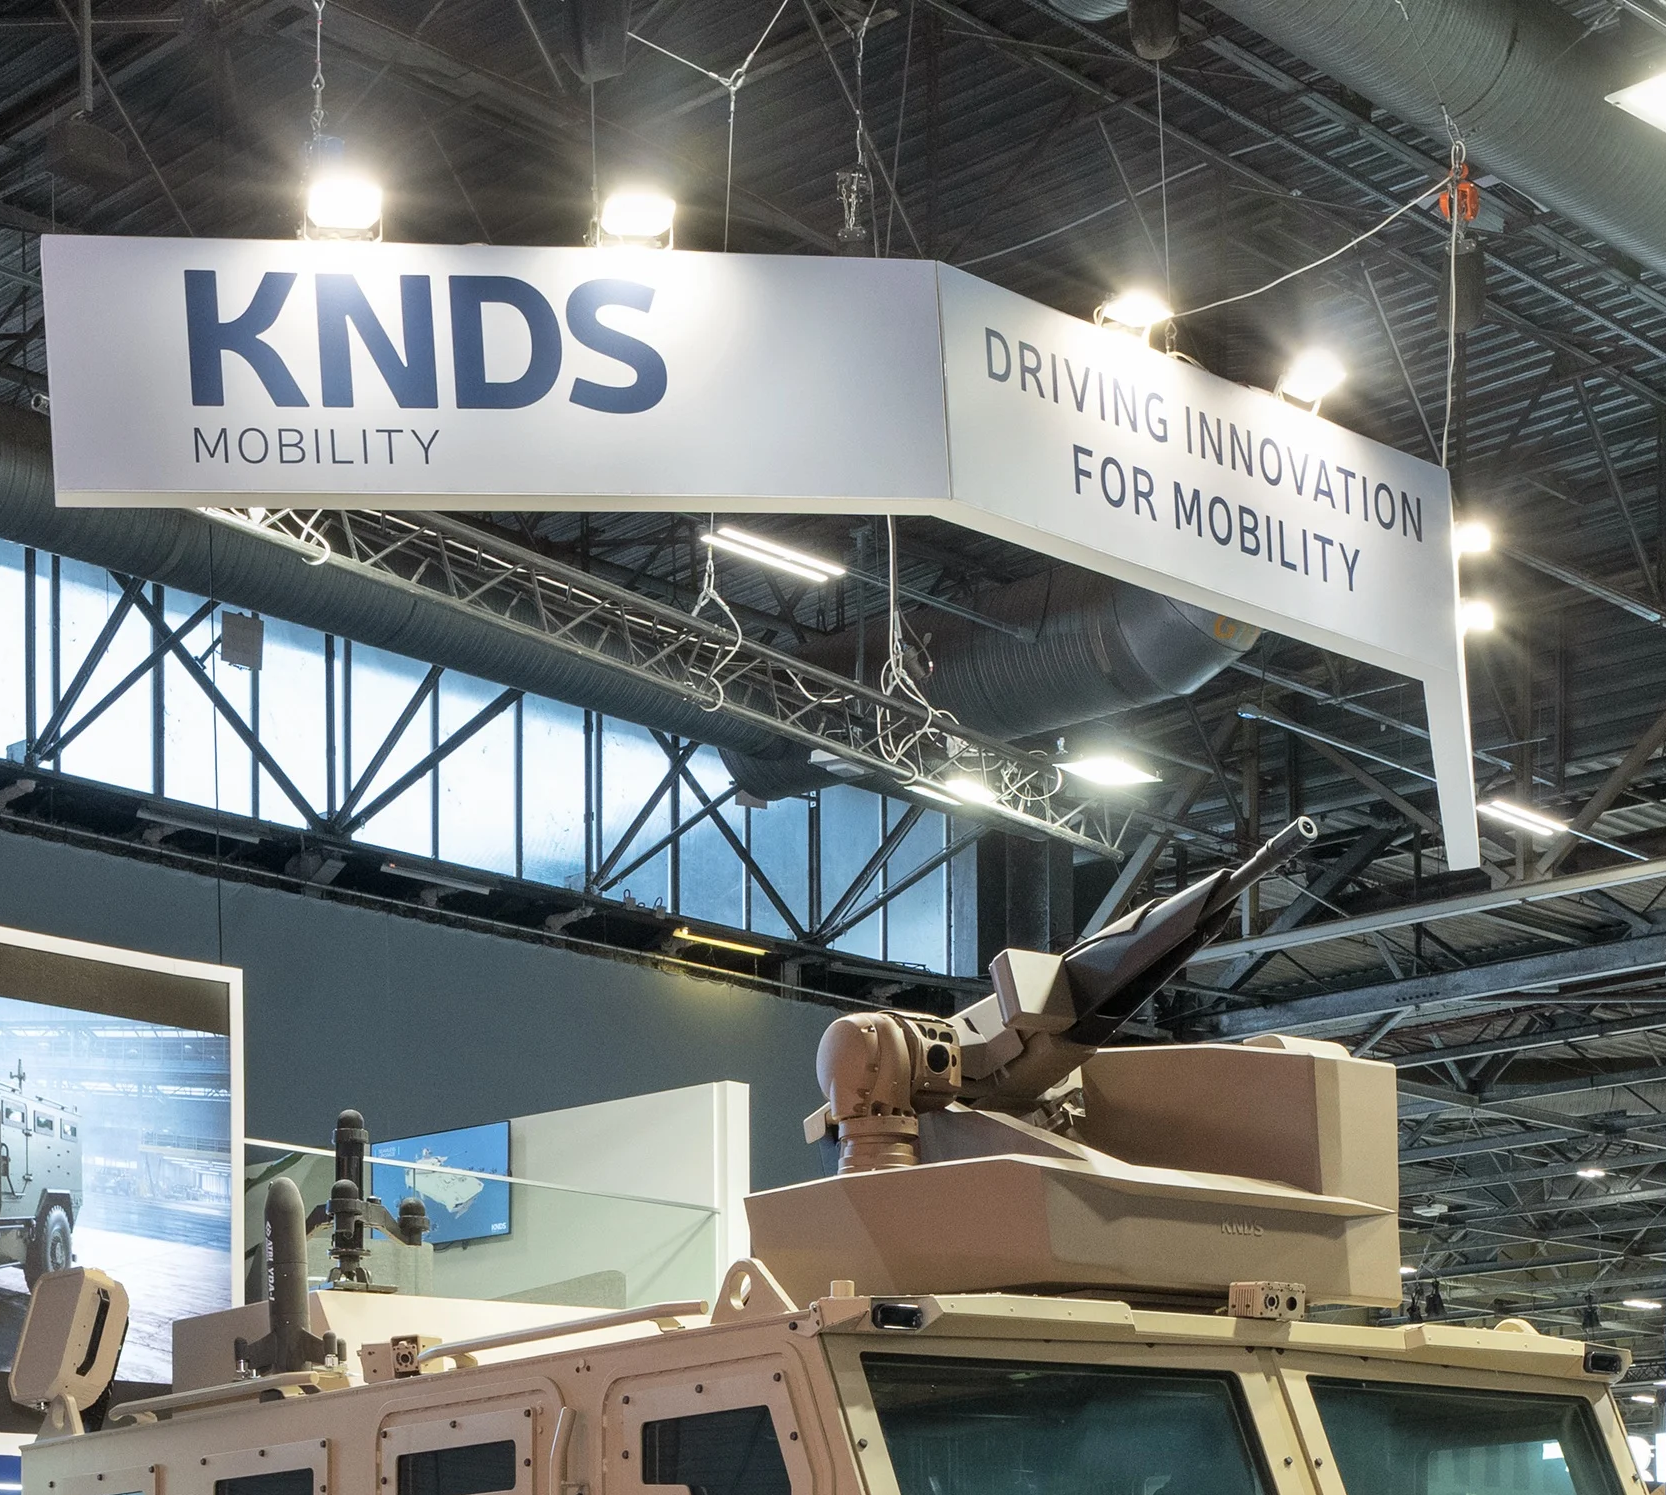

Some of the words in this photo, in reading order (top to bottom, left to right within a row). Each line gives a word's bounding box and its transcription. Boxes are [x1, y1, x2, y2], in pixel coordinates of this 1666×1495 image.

[184, 269, 668, 414] KNDS
[194, 427, 440, 465] MOBILITY
[985, 327, 1168, 443] DRIVING
[1185, 405, 1423, 543] INNOVATION
[1072, 444, 1157, 522] FOR
[1173, 480, 1361, 592] MOBILITY
[491, 1222, 507, 1232] KNDS
